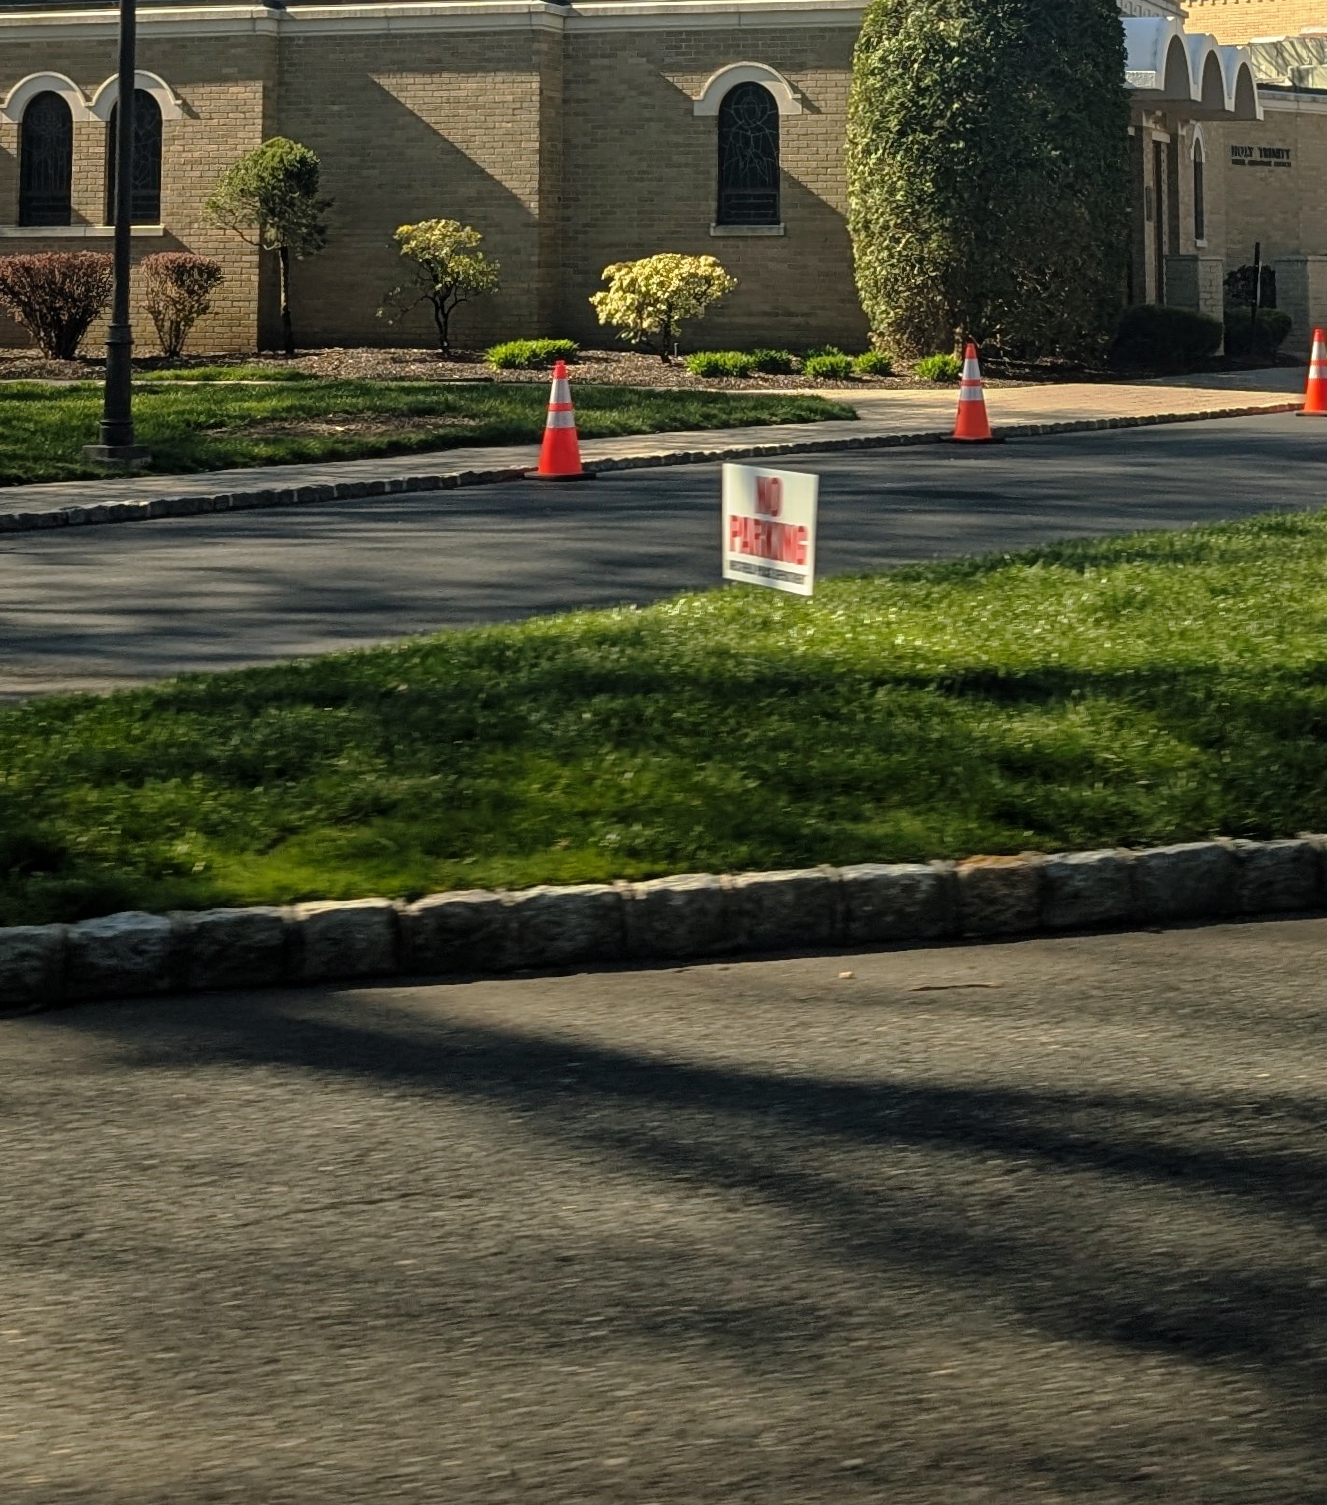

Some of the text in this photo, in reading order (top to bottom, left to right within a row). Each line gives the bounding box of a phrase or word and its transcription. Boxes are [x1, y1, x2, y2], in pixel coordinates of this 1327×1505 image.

[1231, 145, 1290, 159] HOLY TRINITY
[756, 476, 782, 517] NO
[730, 515, 807, 565] PARKING
